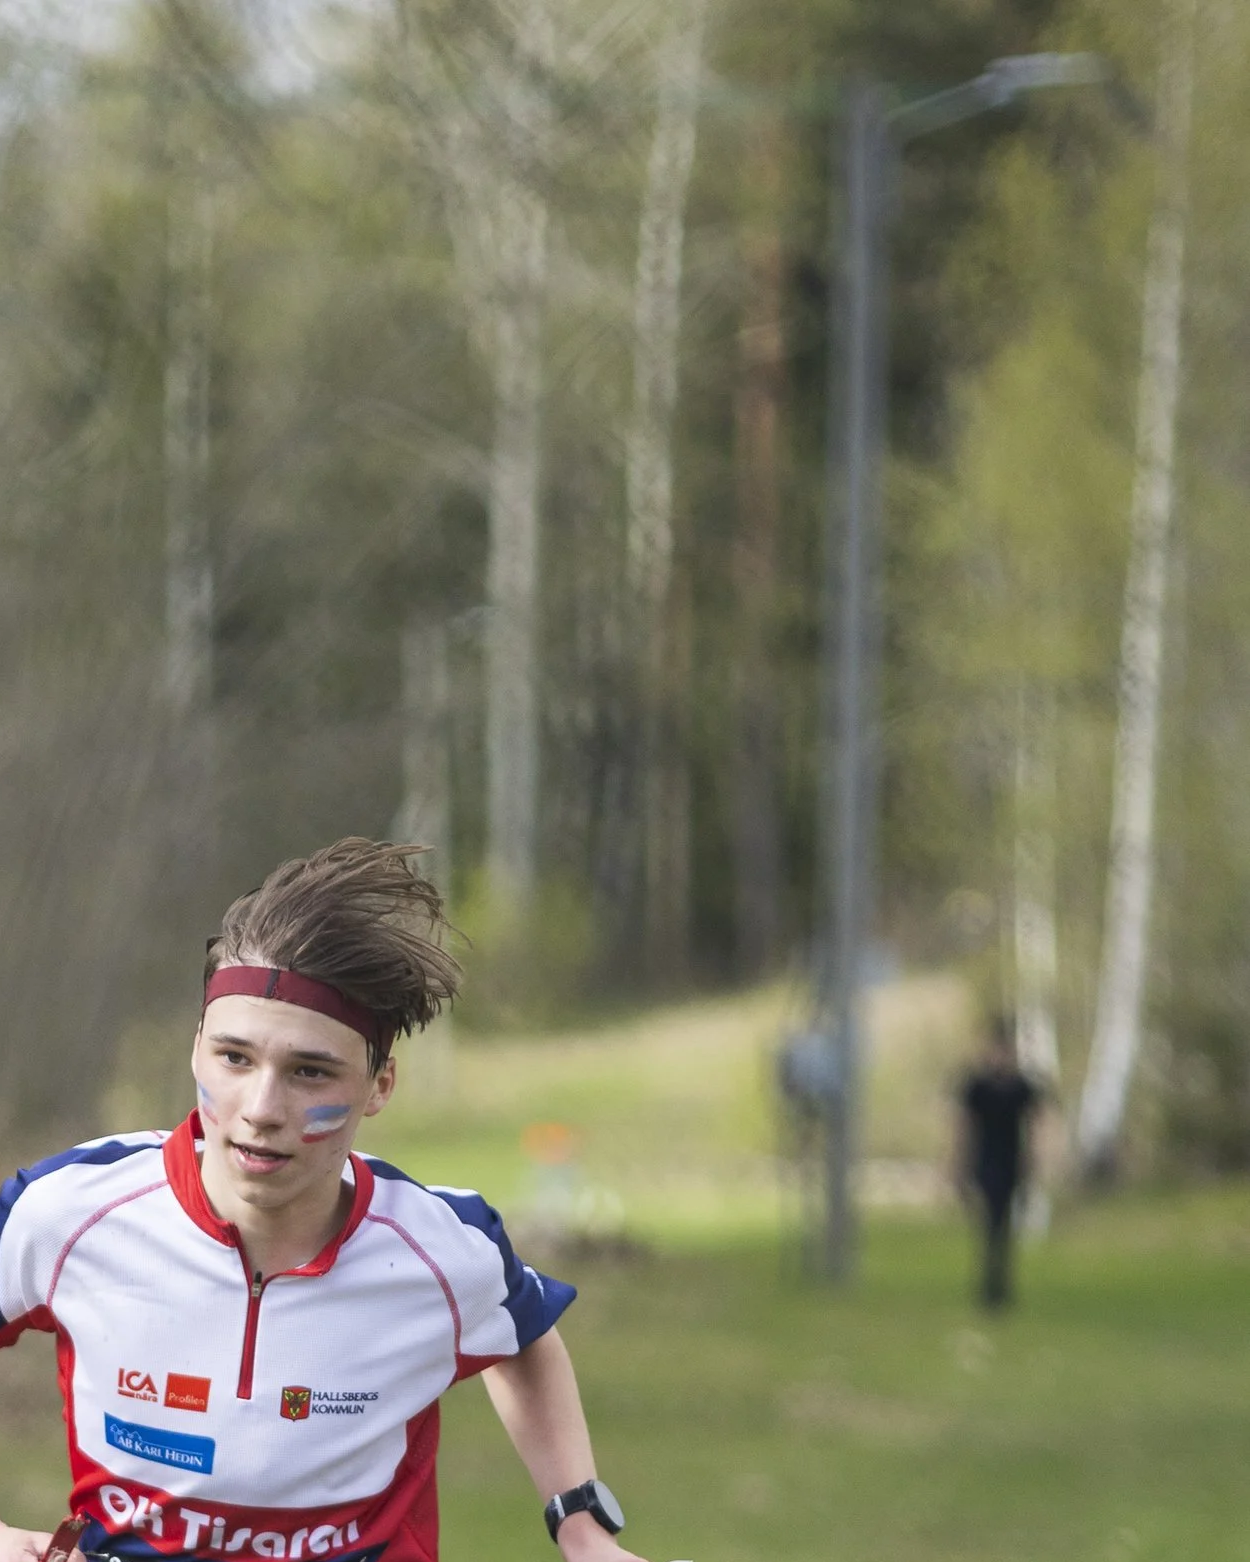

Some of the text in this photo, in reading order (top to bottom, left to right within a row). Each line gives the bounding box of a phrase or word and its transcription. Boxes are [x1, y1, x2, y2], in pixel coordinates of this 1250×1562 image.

[118, 1367, 158, 1394] ICA
[312, 1391, 379, 1402] HALLSBERGS
[311, 1404, 365, 1415] KOMMUN
[99, 1484, 164, 1538] OK
